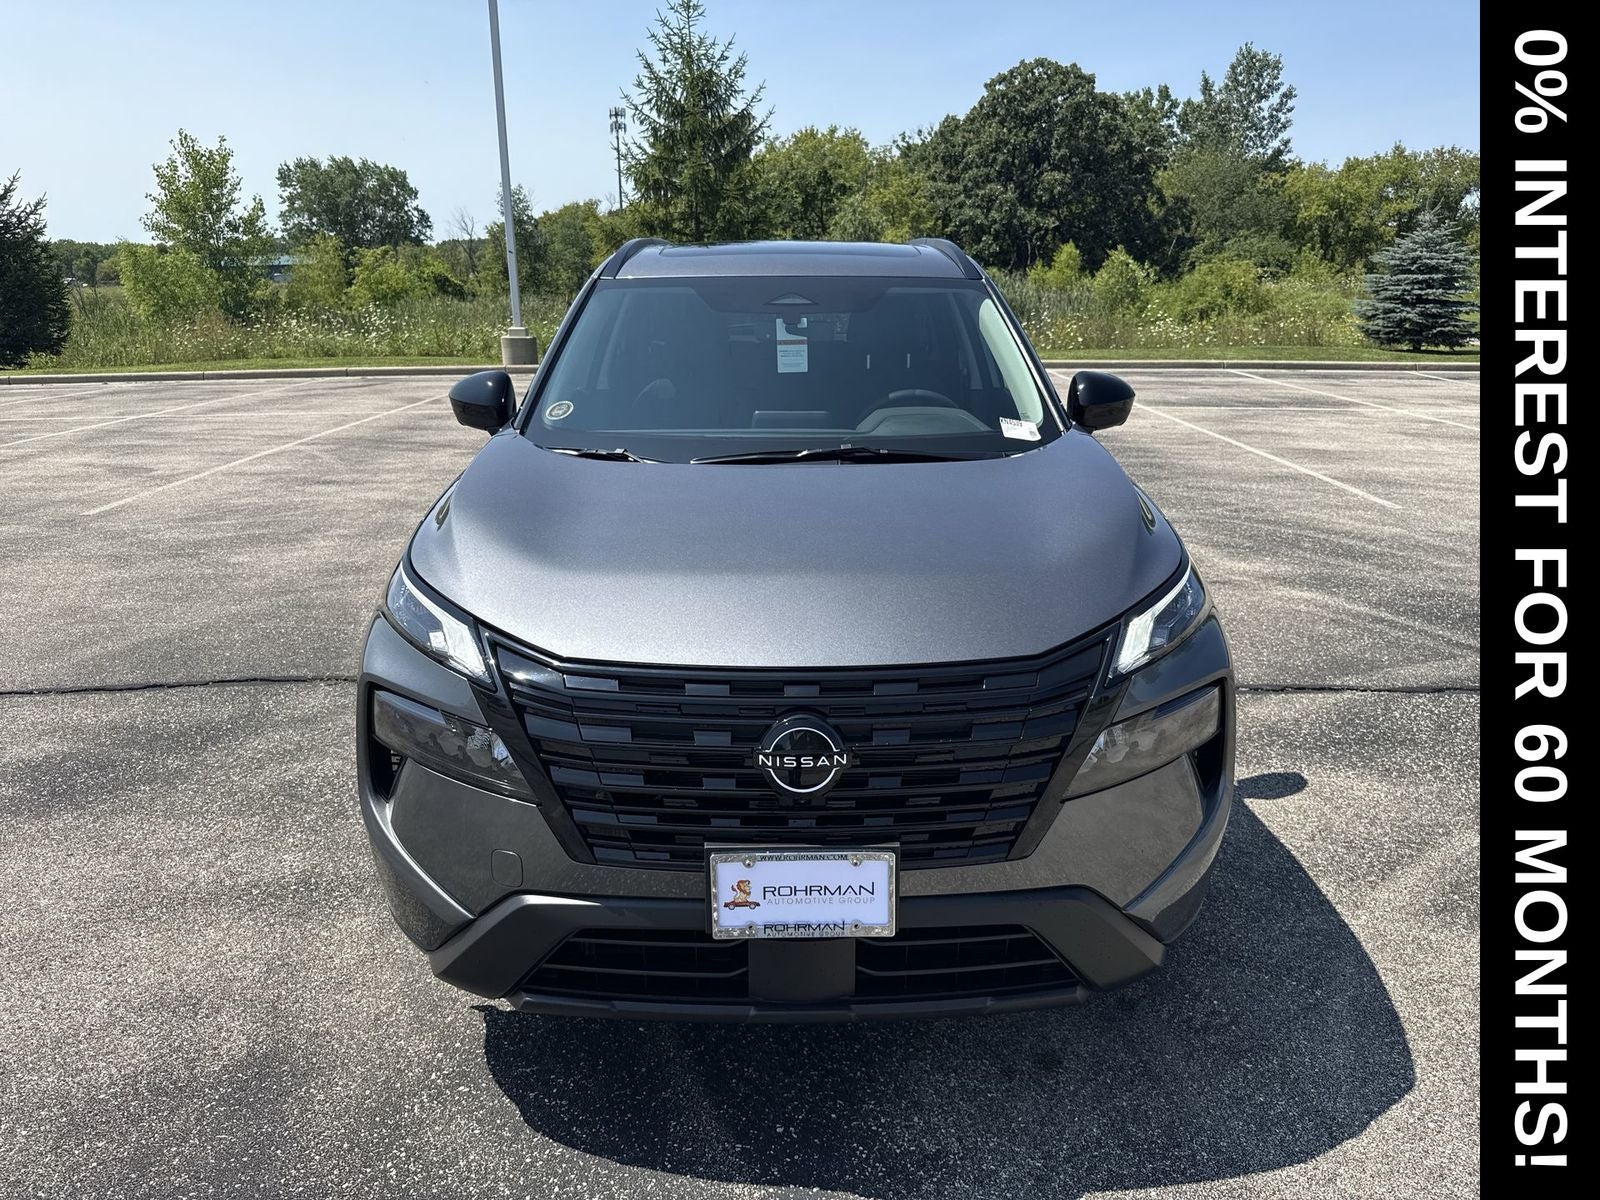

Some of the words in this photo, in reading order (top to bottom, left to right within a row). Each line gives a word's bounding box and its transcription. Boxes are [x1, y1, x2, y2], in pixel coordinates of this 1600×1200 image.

[759, 753, 847, 768] NISSAN
[759, 854, 849, 862] WWW.ROHRMAN.COM
[763, 881, 875, 900] ROHRMAN
[767, 897, 834, 905] AUTOMOTIVE
[839, 896, 876, 905] GROUP
[763, 921, 845, 935] ROHRMAN
